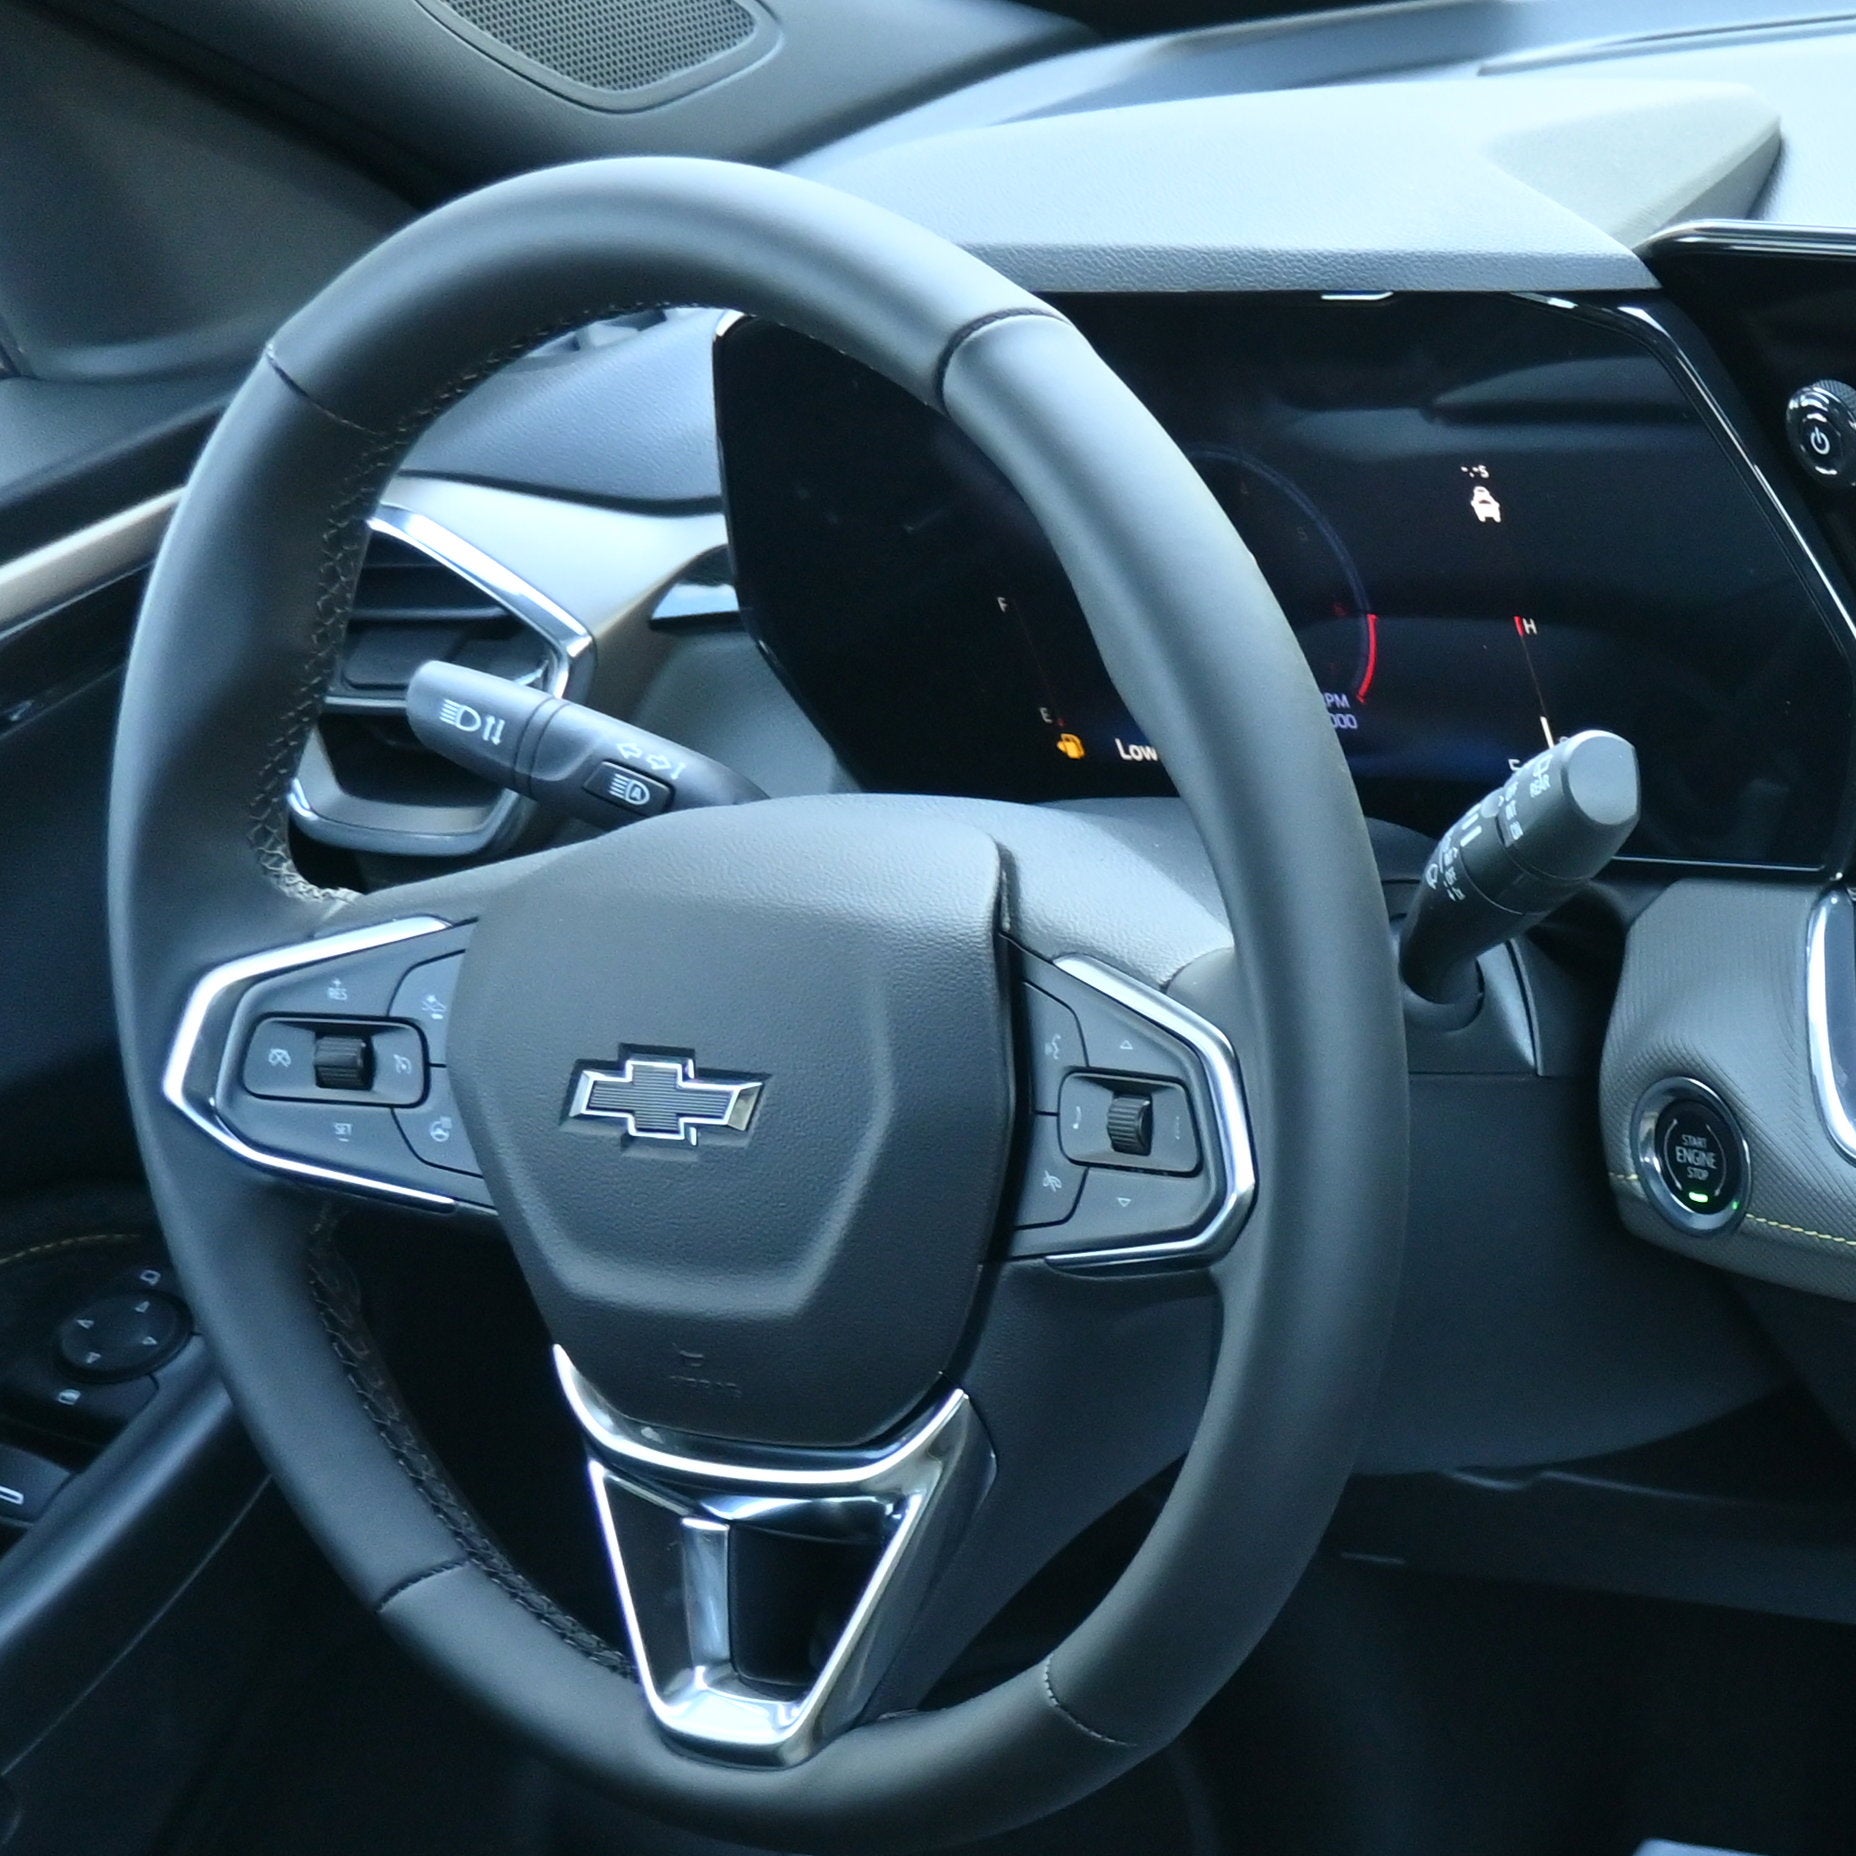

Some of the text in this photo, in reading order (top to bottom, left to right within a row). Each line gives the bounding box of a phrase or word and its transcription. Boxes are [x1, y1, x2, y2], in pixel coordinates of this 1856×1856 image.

[1323, 693, 1350, 708] PM
[1115, 738, 1158, 762] Low
[1681, 1134, 1707, 1149] START
[1675, 1146, 1717, 1169] ENGINE
[1686, 1166, 1710, 1181] STOP
